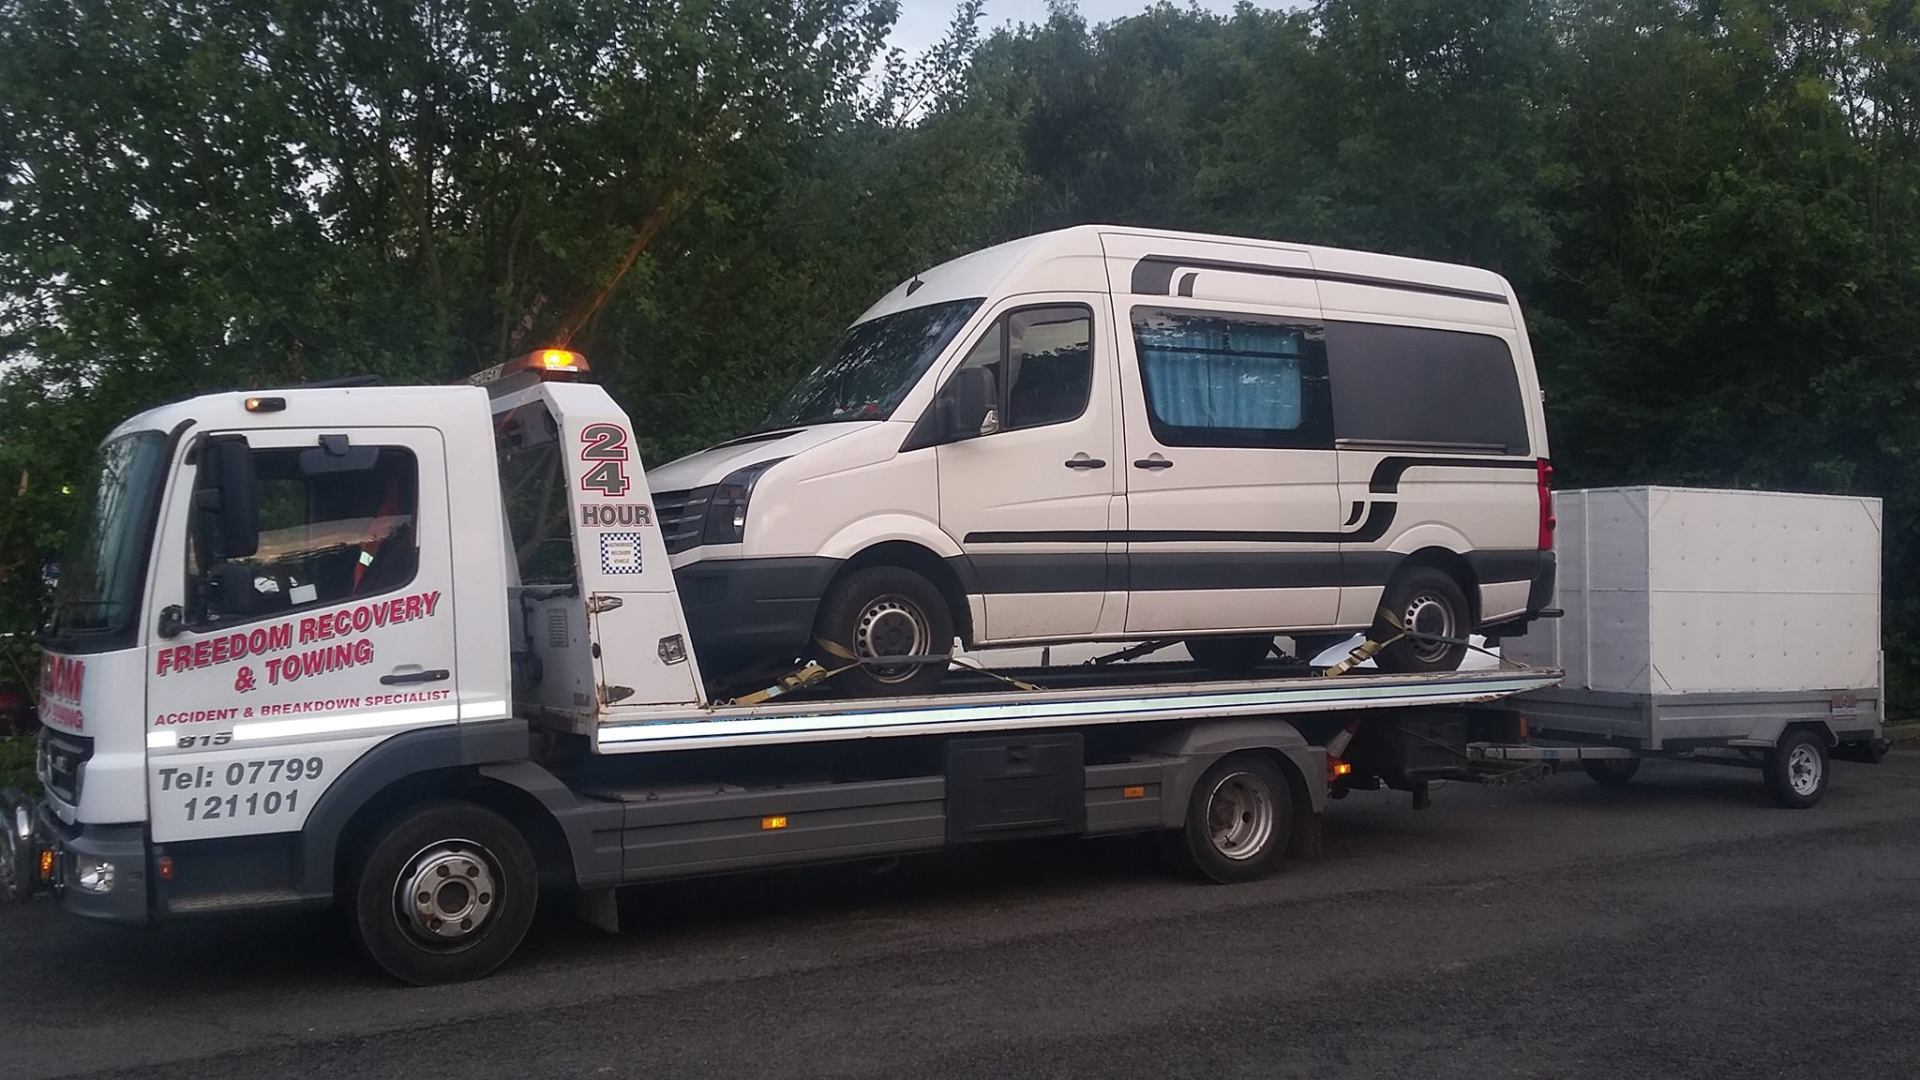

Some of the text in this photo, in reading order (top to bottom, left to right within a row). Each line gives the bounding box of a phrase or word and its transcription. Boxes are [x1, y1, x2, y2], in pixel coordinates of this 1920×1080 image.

[581, 503, 653, 527] HOUR
[156, 590, 441, 677] FREEDOM RECOVERY
[234, 638, 374, 694] & TOWING
[154, 689, 450, 726] ACCIDENT & BREAKDOWN SPECIALIST
[177, 731, 232, 748] 815
[158, 756, 324, 791] Tel: 07799
[184, 789, 298, 821] 121101
